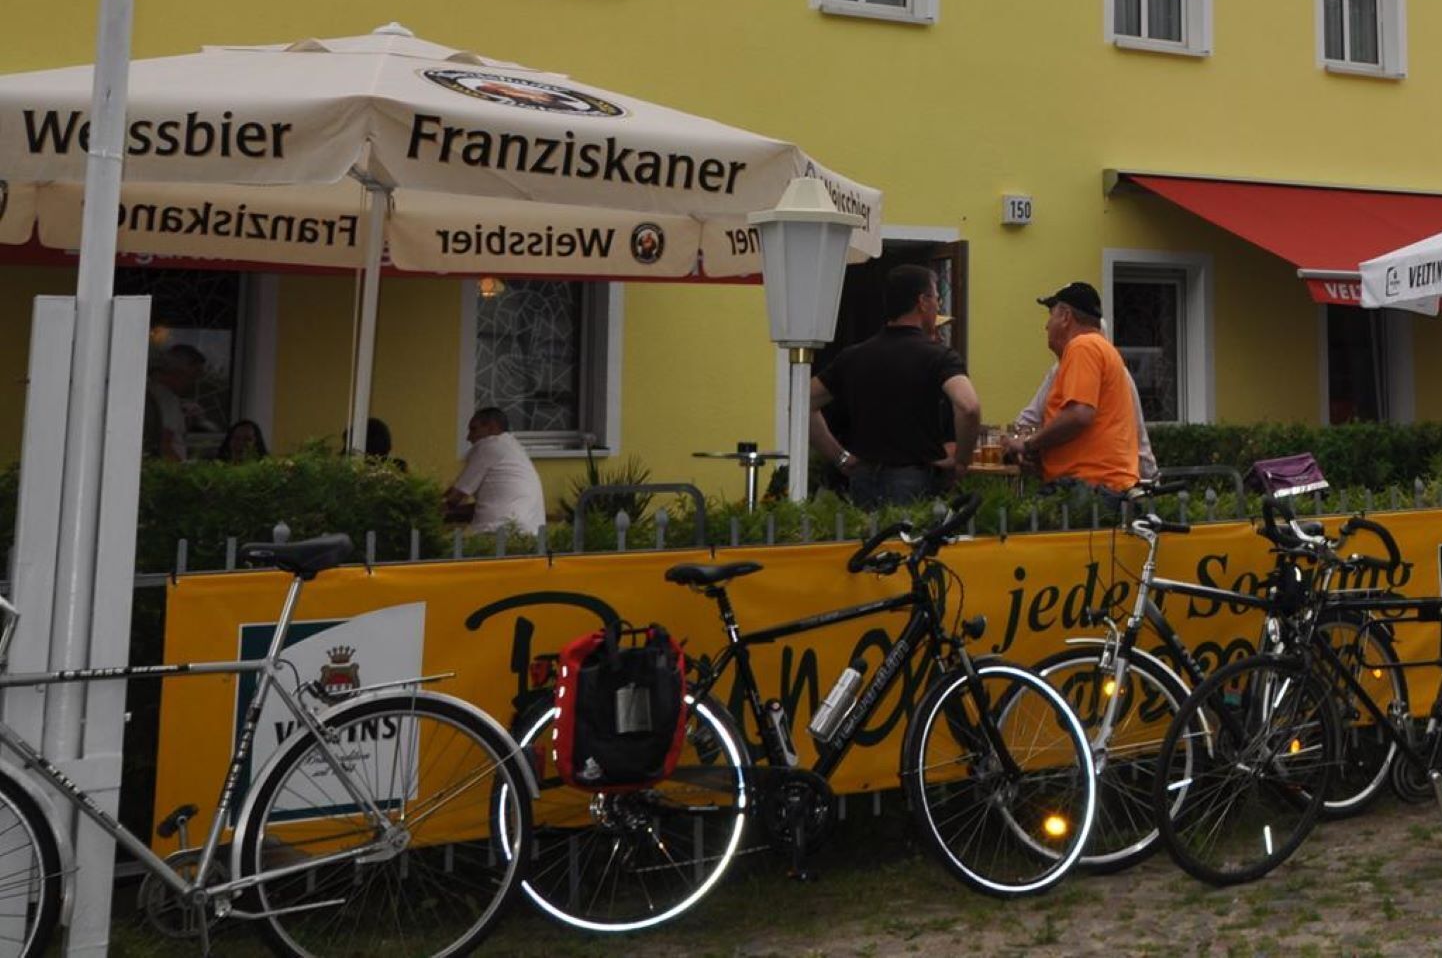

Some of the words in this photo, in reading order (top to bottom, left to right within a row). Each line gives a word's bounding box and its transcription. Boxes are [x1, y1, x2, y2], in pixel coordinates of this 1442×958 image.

[23, 110, 292, 158] Wessbier
[406, 113, 746, 195] Franziskaner
[1010, 200, 1031, 219] 150
[274, 715, 398, 746] VINS
